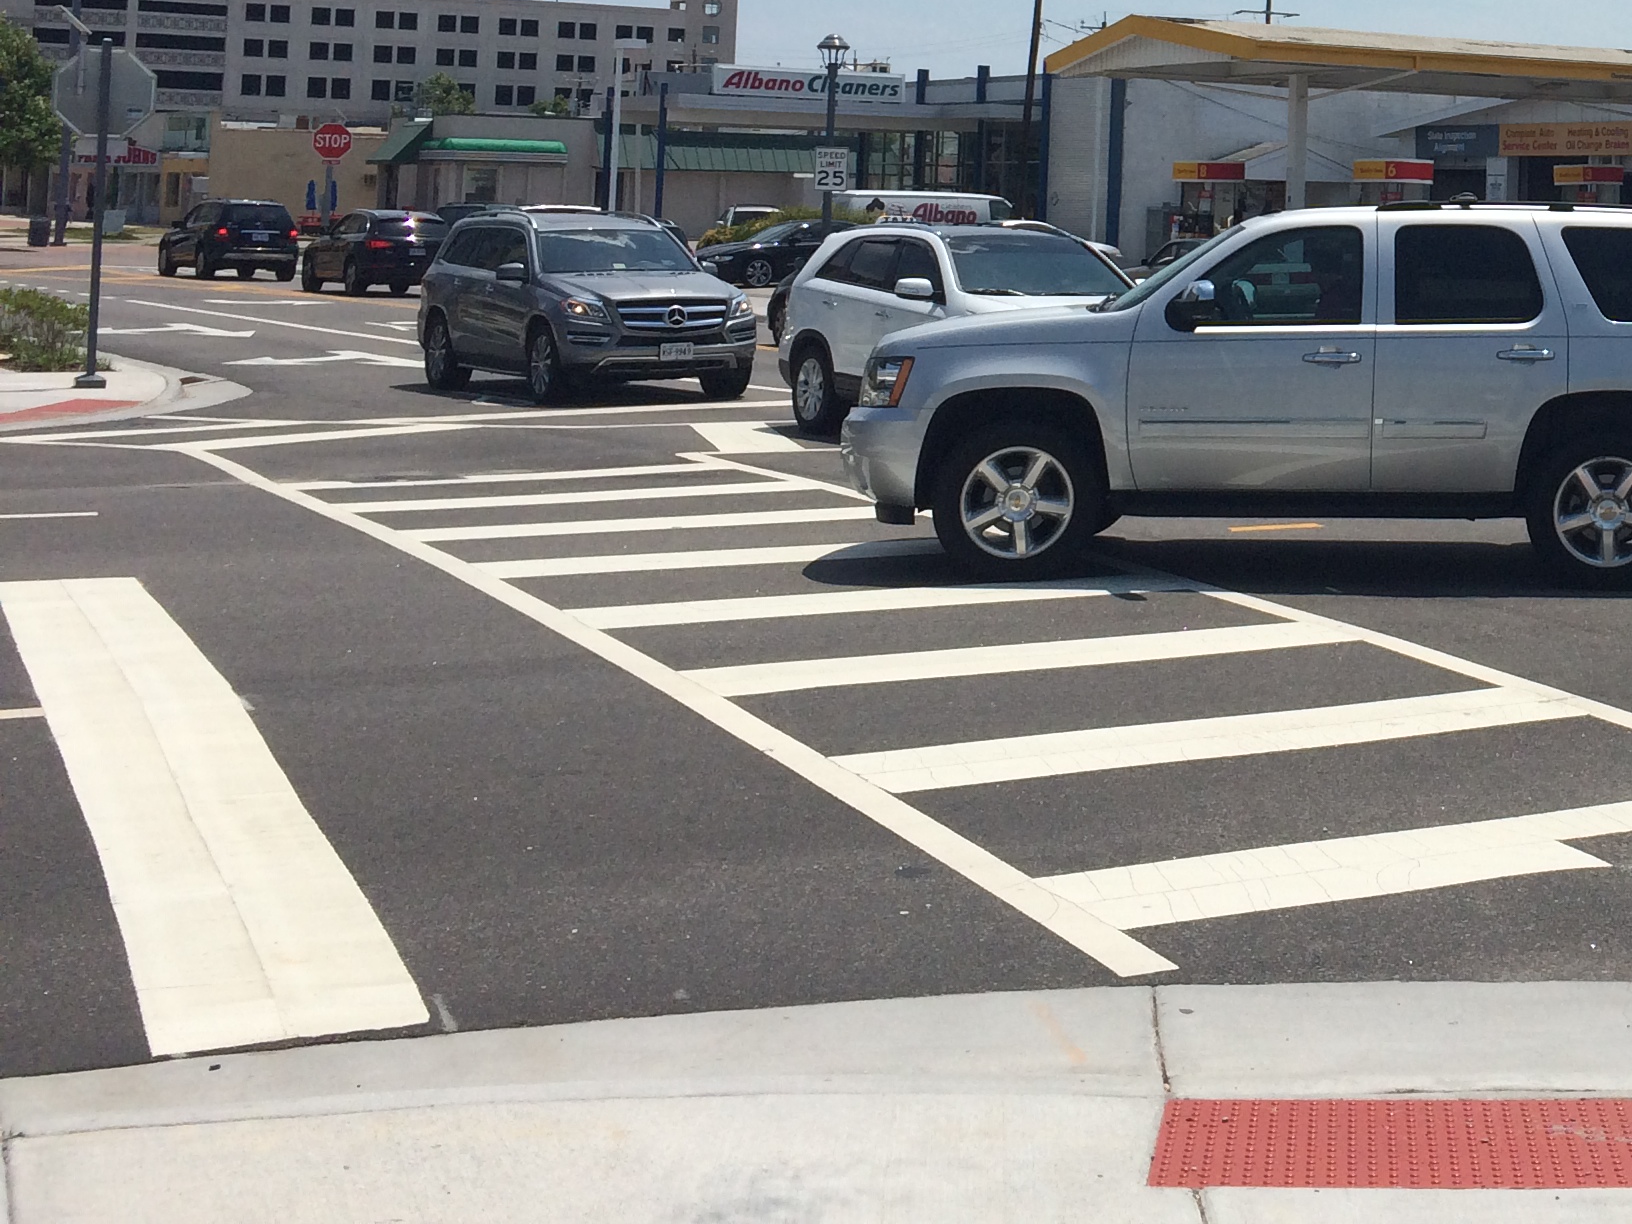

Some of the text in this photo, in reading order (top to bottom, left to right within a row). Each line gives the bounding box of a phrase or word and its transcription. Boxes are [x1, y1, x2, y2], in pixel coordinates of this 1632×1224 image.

[723, 71, 900, 97] Albano Claners
[1601, 126, 1629, 138] Cooling
[315, 134, 350, 148] STOP
[817, 151, 846, 160] SPEED
[820, 160, 842, 168] LIMIT
[1387, 163, 1397, 177] 6
[817, 170, 844, 187] 25
[912, 202, 977, 224] Albano
